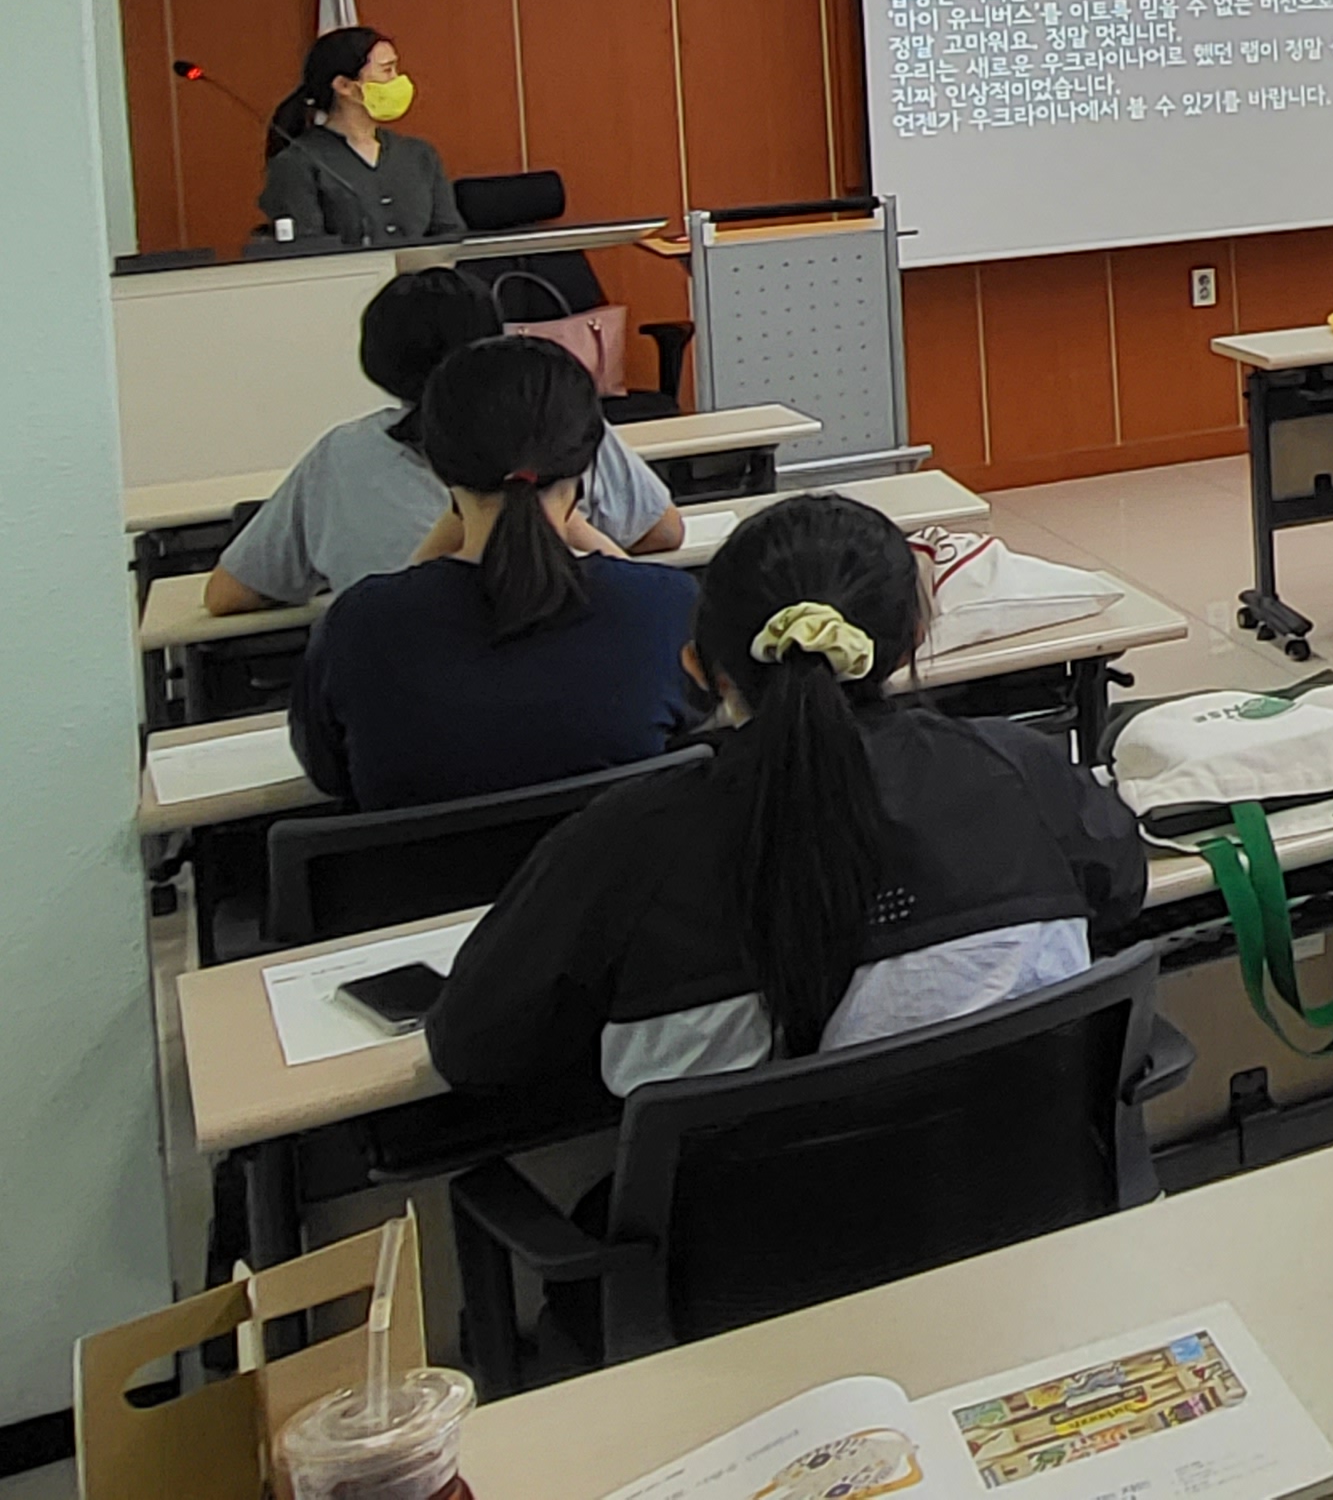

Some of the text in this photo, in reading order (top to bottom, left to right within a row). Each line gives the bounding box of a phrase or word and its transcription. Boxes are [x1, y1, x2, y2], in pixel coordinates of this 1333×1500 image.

[1069, 0, 1131, 23] 이토록
[889, 20, 1182, 60] 정말 고마워요. 정말 멋집니다.
[889, 59, 960, 86] 우리는
[966, 54, 1034, 80] 새로운
[1041, 45, 1187, 75] 우크라이나어로
[1193, 41, 1233, 66] 했던
[1240, 38, 1279, 64] 랩이
[1284, 36, 1324, 62] 정말
[891, 73, 1121, 111] 진짜 인상적이었습니다.
[892, 84, 1332, 137] 언젠가 우크라이나에서 볼 수 있기를 바랍니다.
